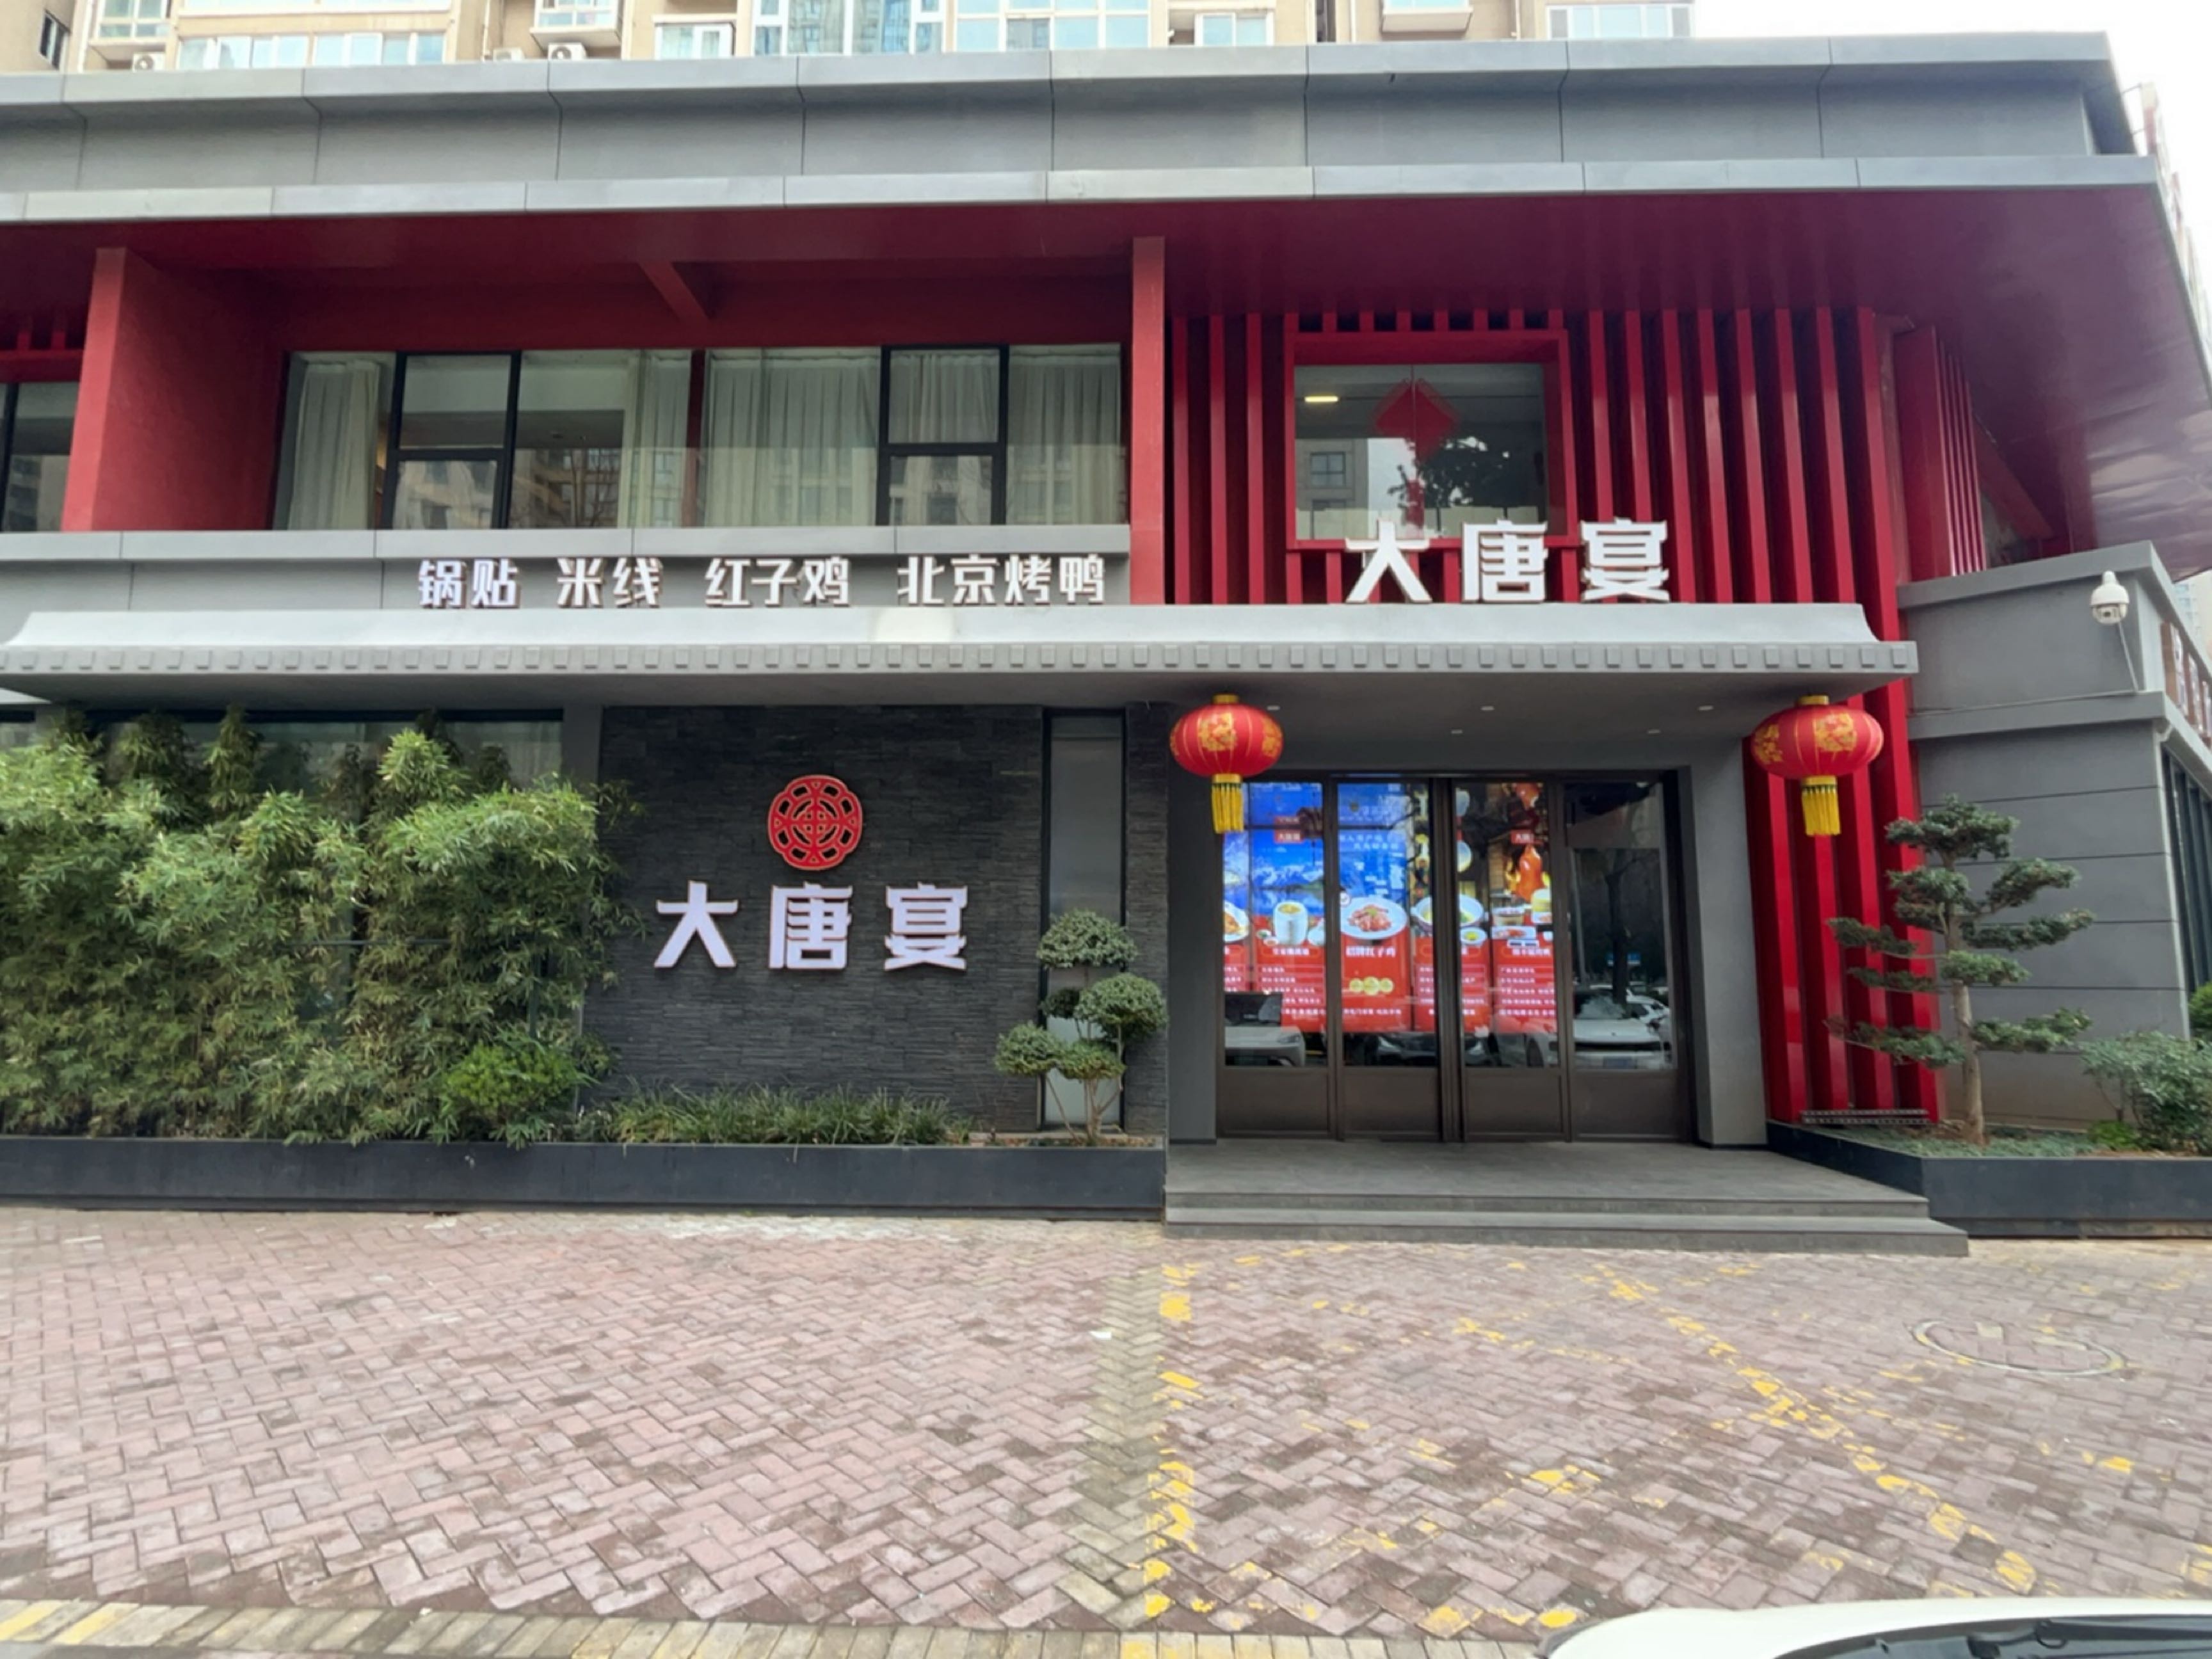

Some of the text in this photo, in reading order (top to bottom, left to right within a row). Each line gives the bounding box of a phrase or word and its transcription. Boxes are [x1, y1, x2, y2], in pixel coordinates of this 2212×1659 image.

[418, 554, 1105, 608] 锅贴 米线 红子鸡 北京烤鸭
[1345, 518, 1670, 603] 大唐宴
[653, 880, 968, 971] 大唐宴
